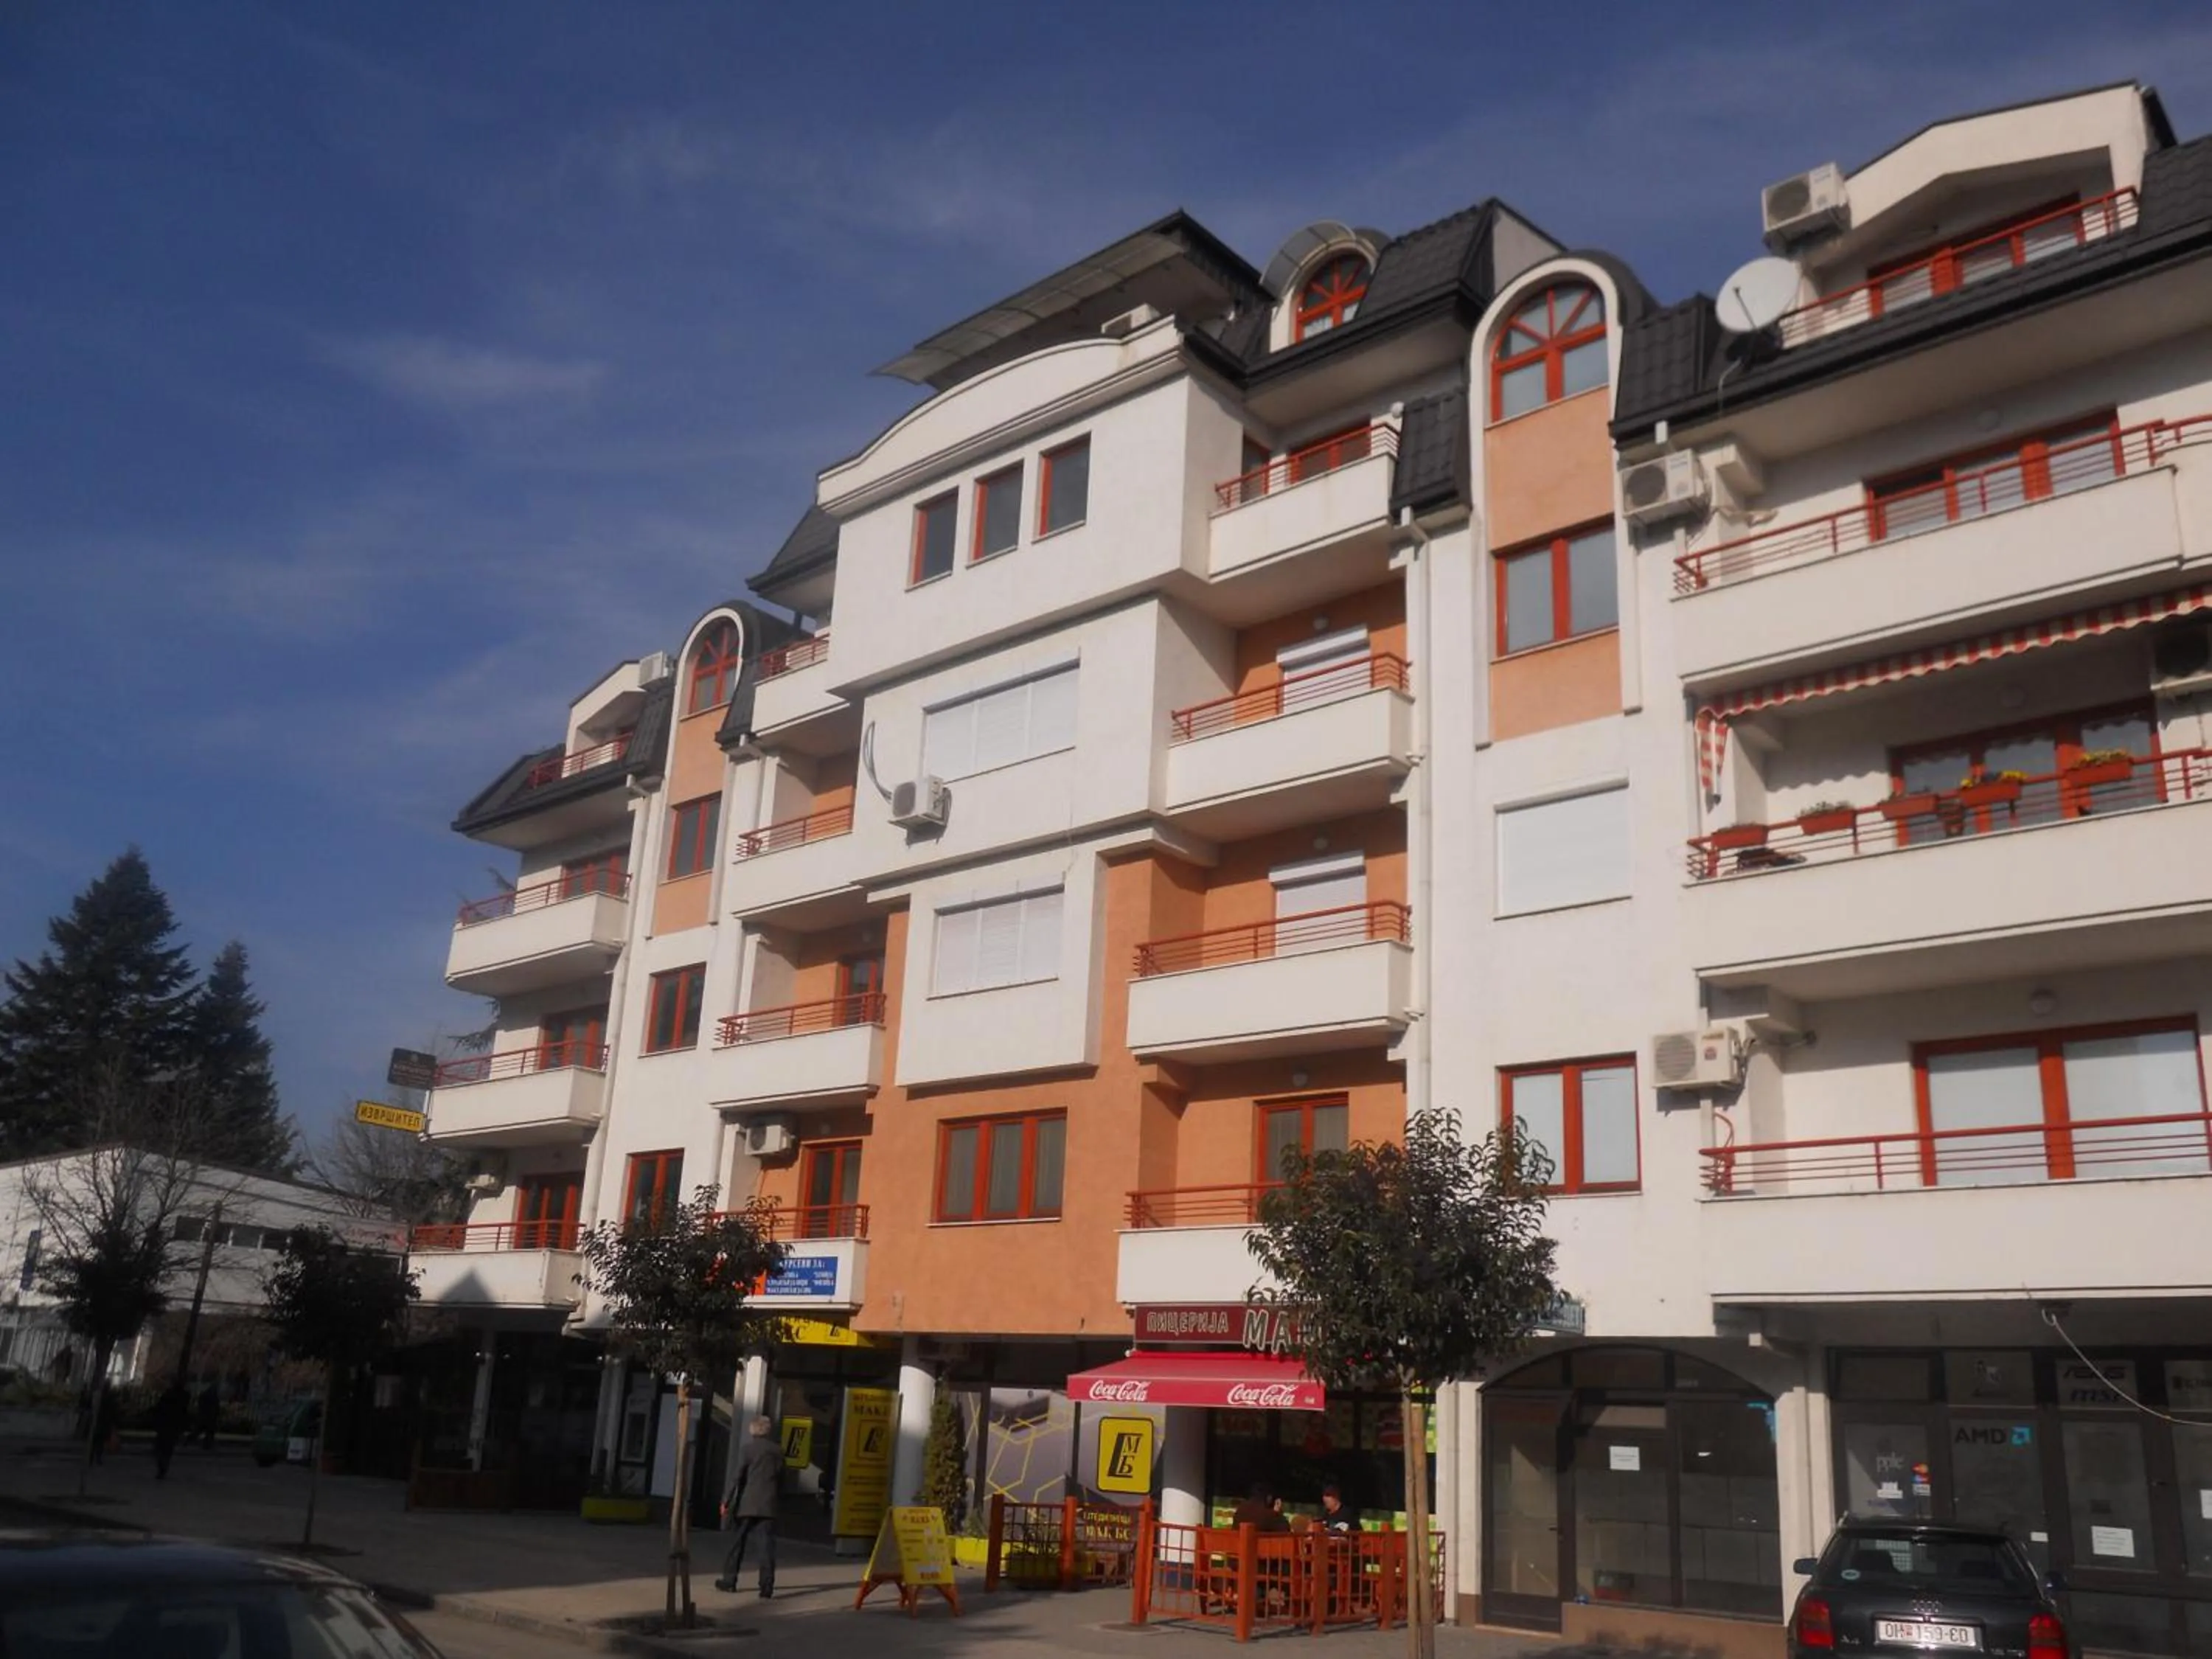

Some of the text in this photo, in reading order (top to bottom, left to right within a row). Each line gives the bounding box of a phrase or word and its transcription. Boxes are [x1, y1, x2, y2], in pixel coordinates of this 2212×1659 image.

[1147, 1312, 1229, 1335] ПИЦЕРИЈА
[1088, 1380, 1152, 1402] Coca-Cola
[1227, 1382, 1298, 1406] Coca-Cola
[1954, 1427, 2007, 1445] AMD
